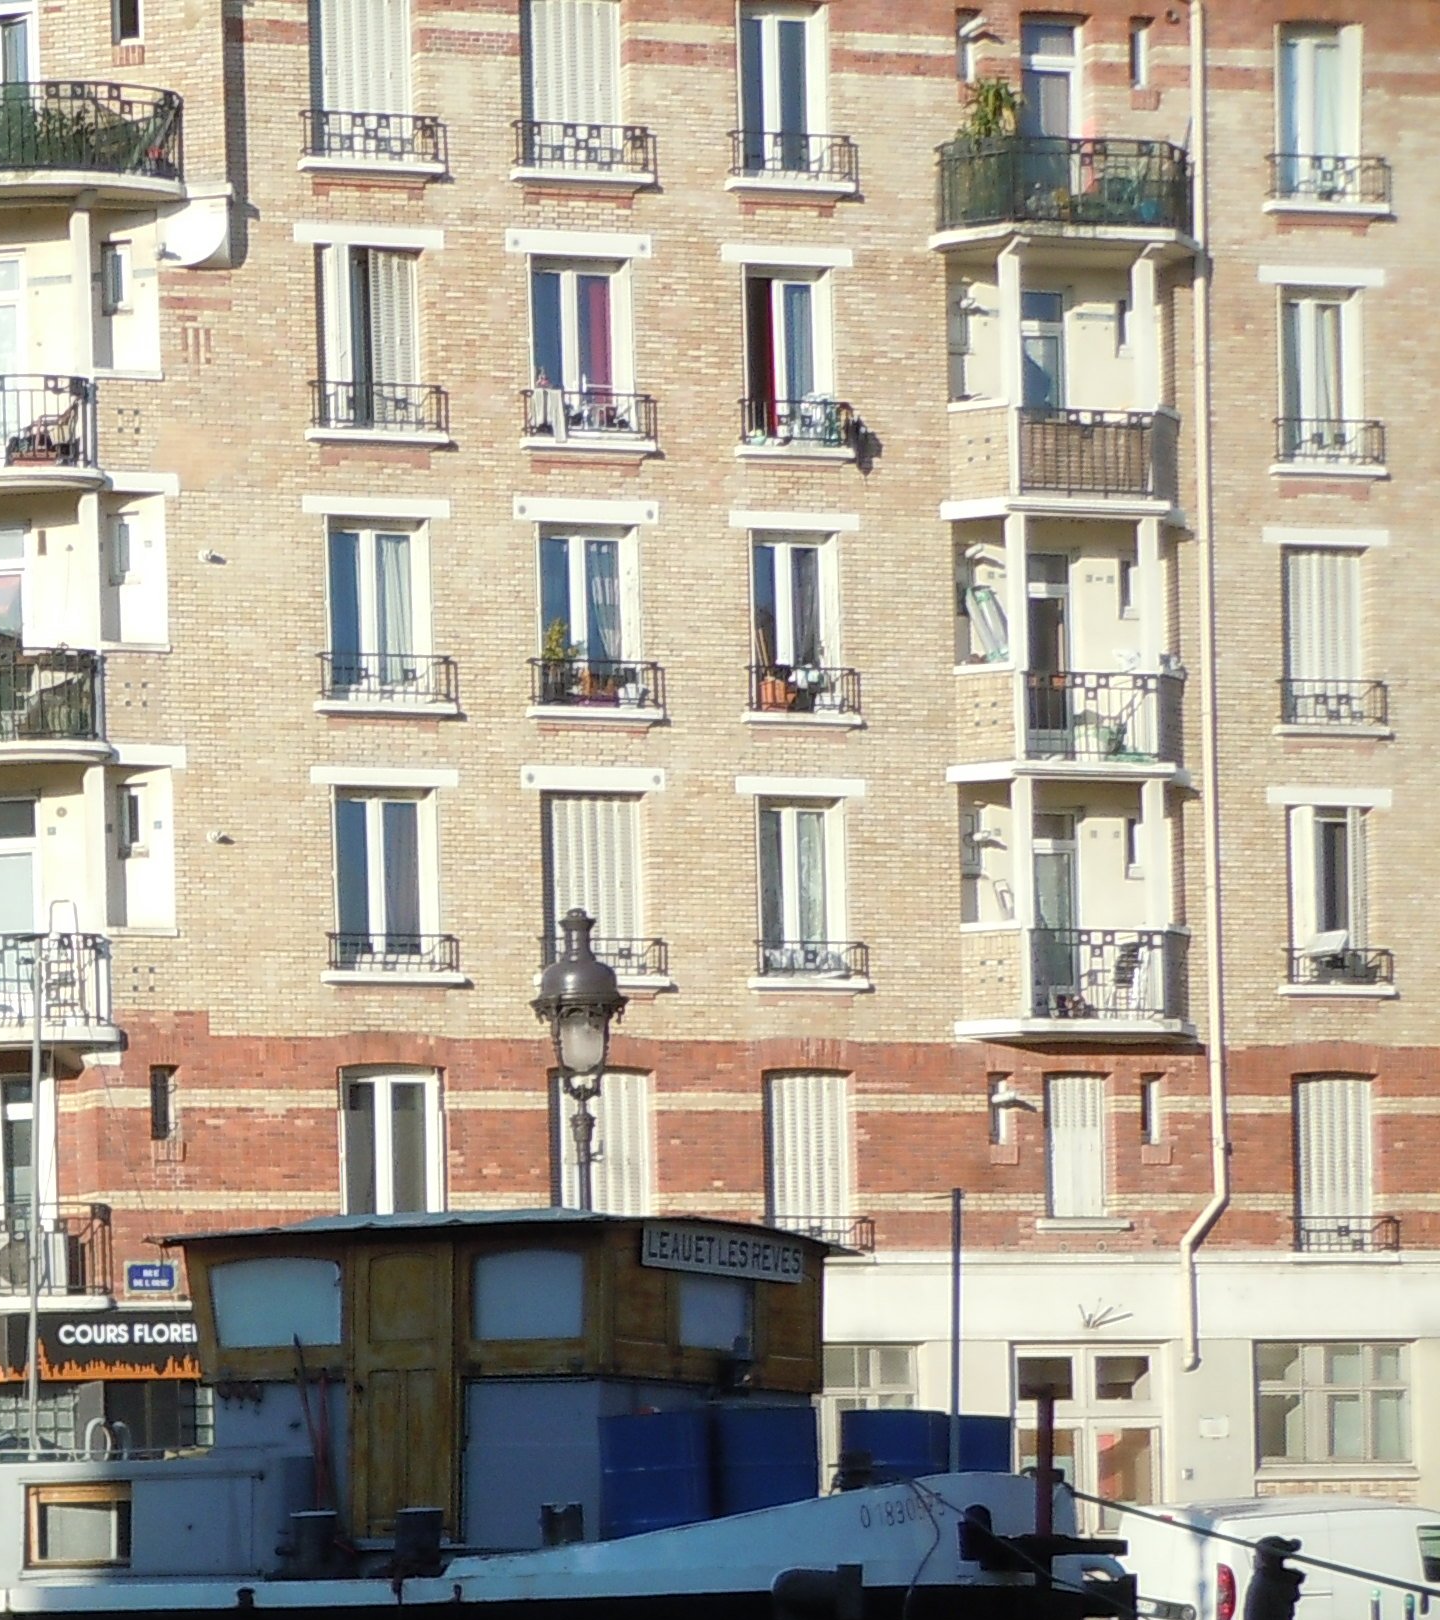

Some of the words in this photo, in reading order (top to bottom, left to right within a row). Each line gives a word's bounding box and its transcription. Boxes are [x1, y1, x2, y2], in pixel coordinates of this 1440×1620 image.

[694, 1235, 715, 1265] ET
[718, 1239, 749, 1268] LES
[58, 1323, 129, 1344] COURS
